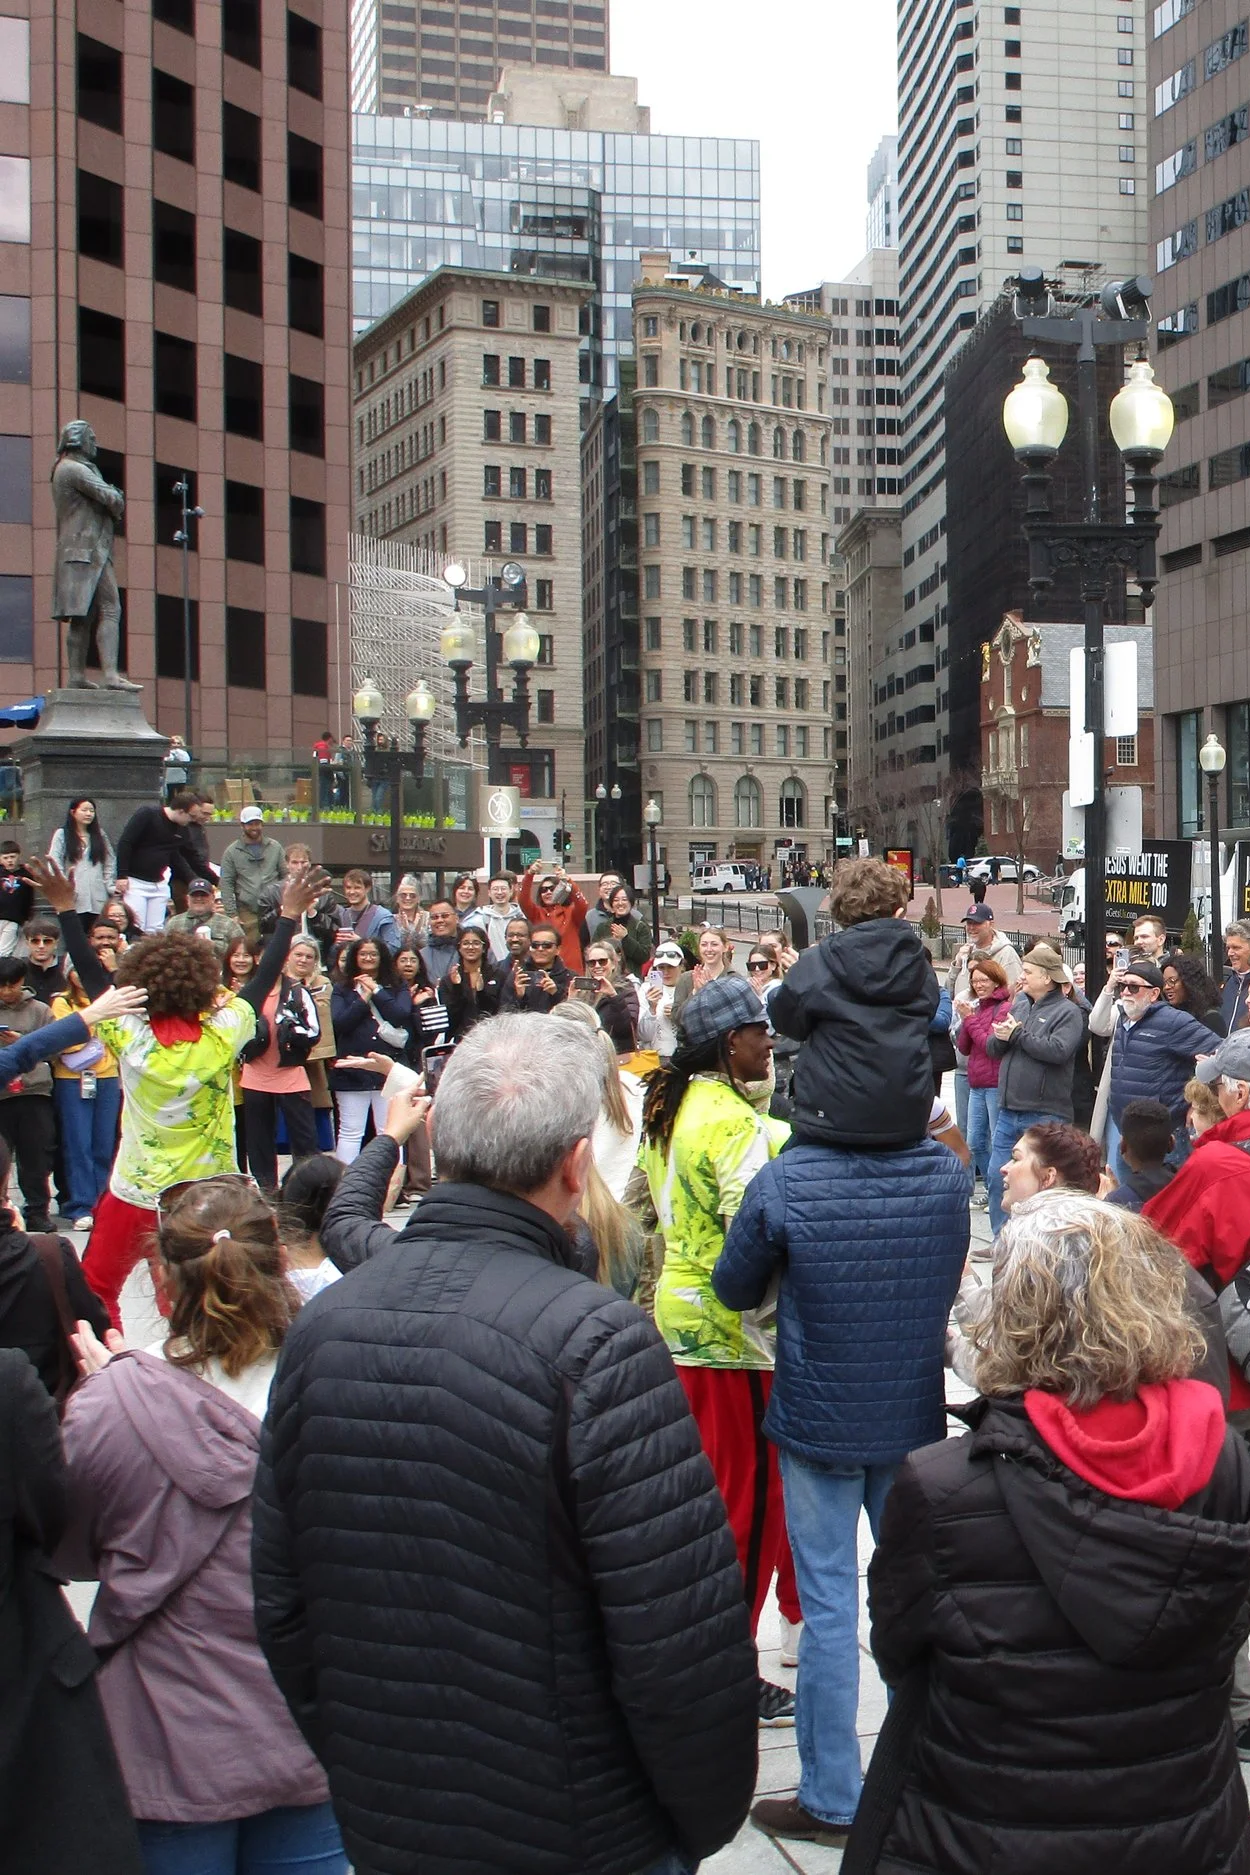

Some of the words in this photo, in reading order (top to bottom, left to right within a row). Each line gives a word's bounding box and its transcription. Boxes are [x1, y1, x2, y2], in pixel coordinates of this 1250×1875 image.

[1128, 853, 1152, 877] WENT
[1153, 853, 1168, 878] THE
[1128, 881, 1150, 909] MILE,
[1151, 882, 1168, 907] TOO
[1105, 908, 1138, 920] eGetsUs.com
